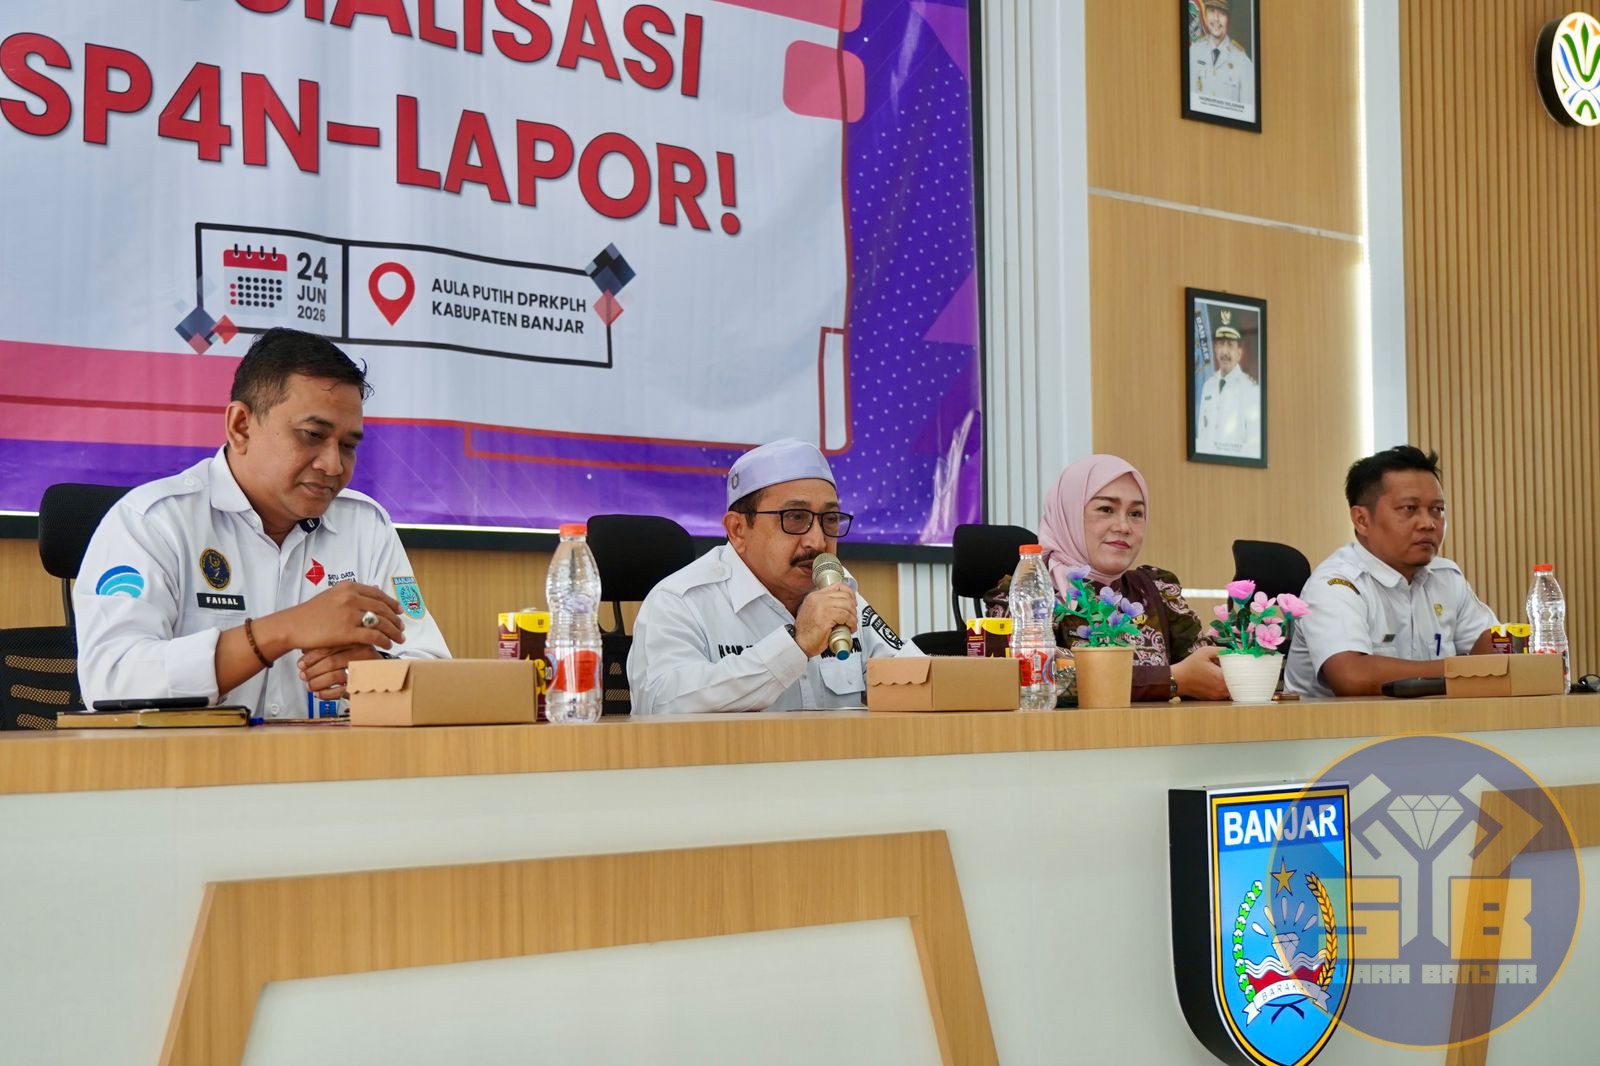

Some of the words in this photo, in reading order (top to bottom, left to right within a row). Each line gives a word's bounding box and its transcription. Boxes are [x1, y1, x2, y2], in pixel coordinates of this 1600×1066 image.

[0, 33, 741, 235] SP4N-LAPOR!
[296, 251, 329, 285] 24
[296, 284, 327, 305] JUN
[431, 278, 470, 298] AULA
[472, 284, 514, 305] PUTIH
[517, 291, 586, 313] DPRKPLH
[297, 304, 326, 322] 2026
[432, 300, 518, 327] KABUPATEN
[521, 314, 584, 334] BANJAR
[340, 571, 356, 579] DATA
[205, 596, 239, 605] FAISAL
[1223, 804, 1338, 846] BANJAR
